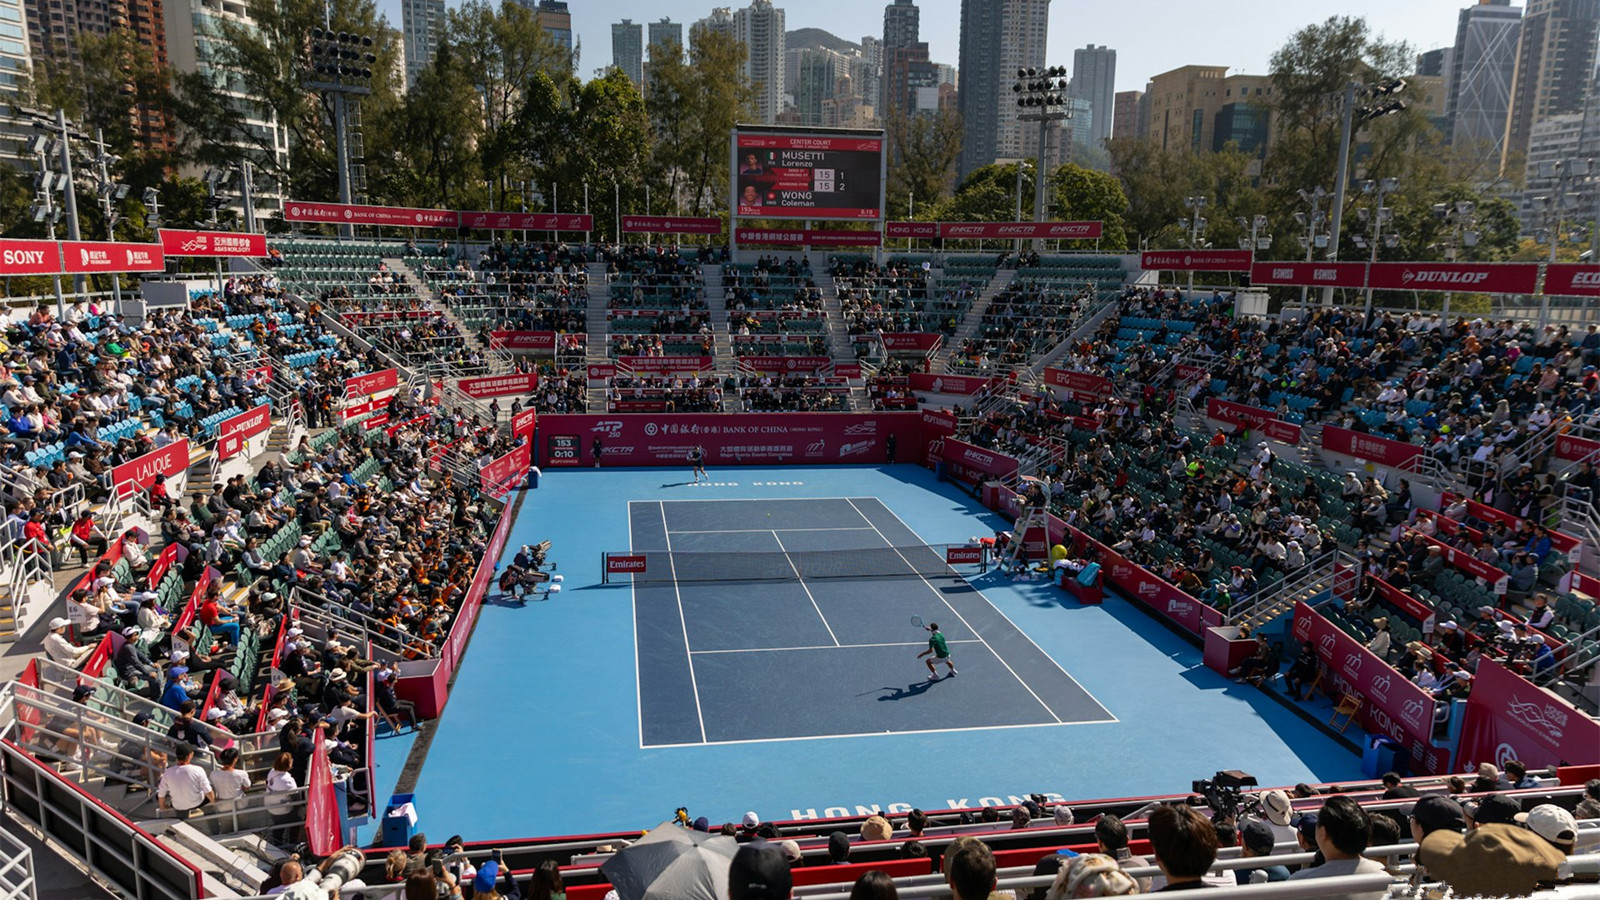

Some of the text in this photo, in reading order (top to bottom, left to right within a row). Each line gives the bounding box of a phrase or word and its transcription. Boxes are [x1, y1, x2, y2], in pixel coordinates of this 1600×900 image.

[782, 151, 824, 160] MUSETTI
[782, 192, 812, 200] WONG
[4, 250, 44, 264] SONY
[1272, 268, 1294, 279] K-SWISS
[1313, 268, 1337, 281] K-SWISS
[1414, 271, 1488, 284] DUNLOP
[1056, 372, 1070, 384] EFG
[236, 413, 264, 432] DUNLOP
[590, 421, 623, 432] ATP
[968, 450, 993, 464] HKCTA
[136, 453, 172, 482] LALIQUE
[610, 560, 644, 568] Emirates
[1334, 674, 1404, 743] HONG KONG
[1412, 739, 1438, 774] 香港
[790, 792, 1067, 820] HONG KONG
